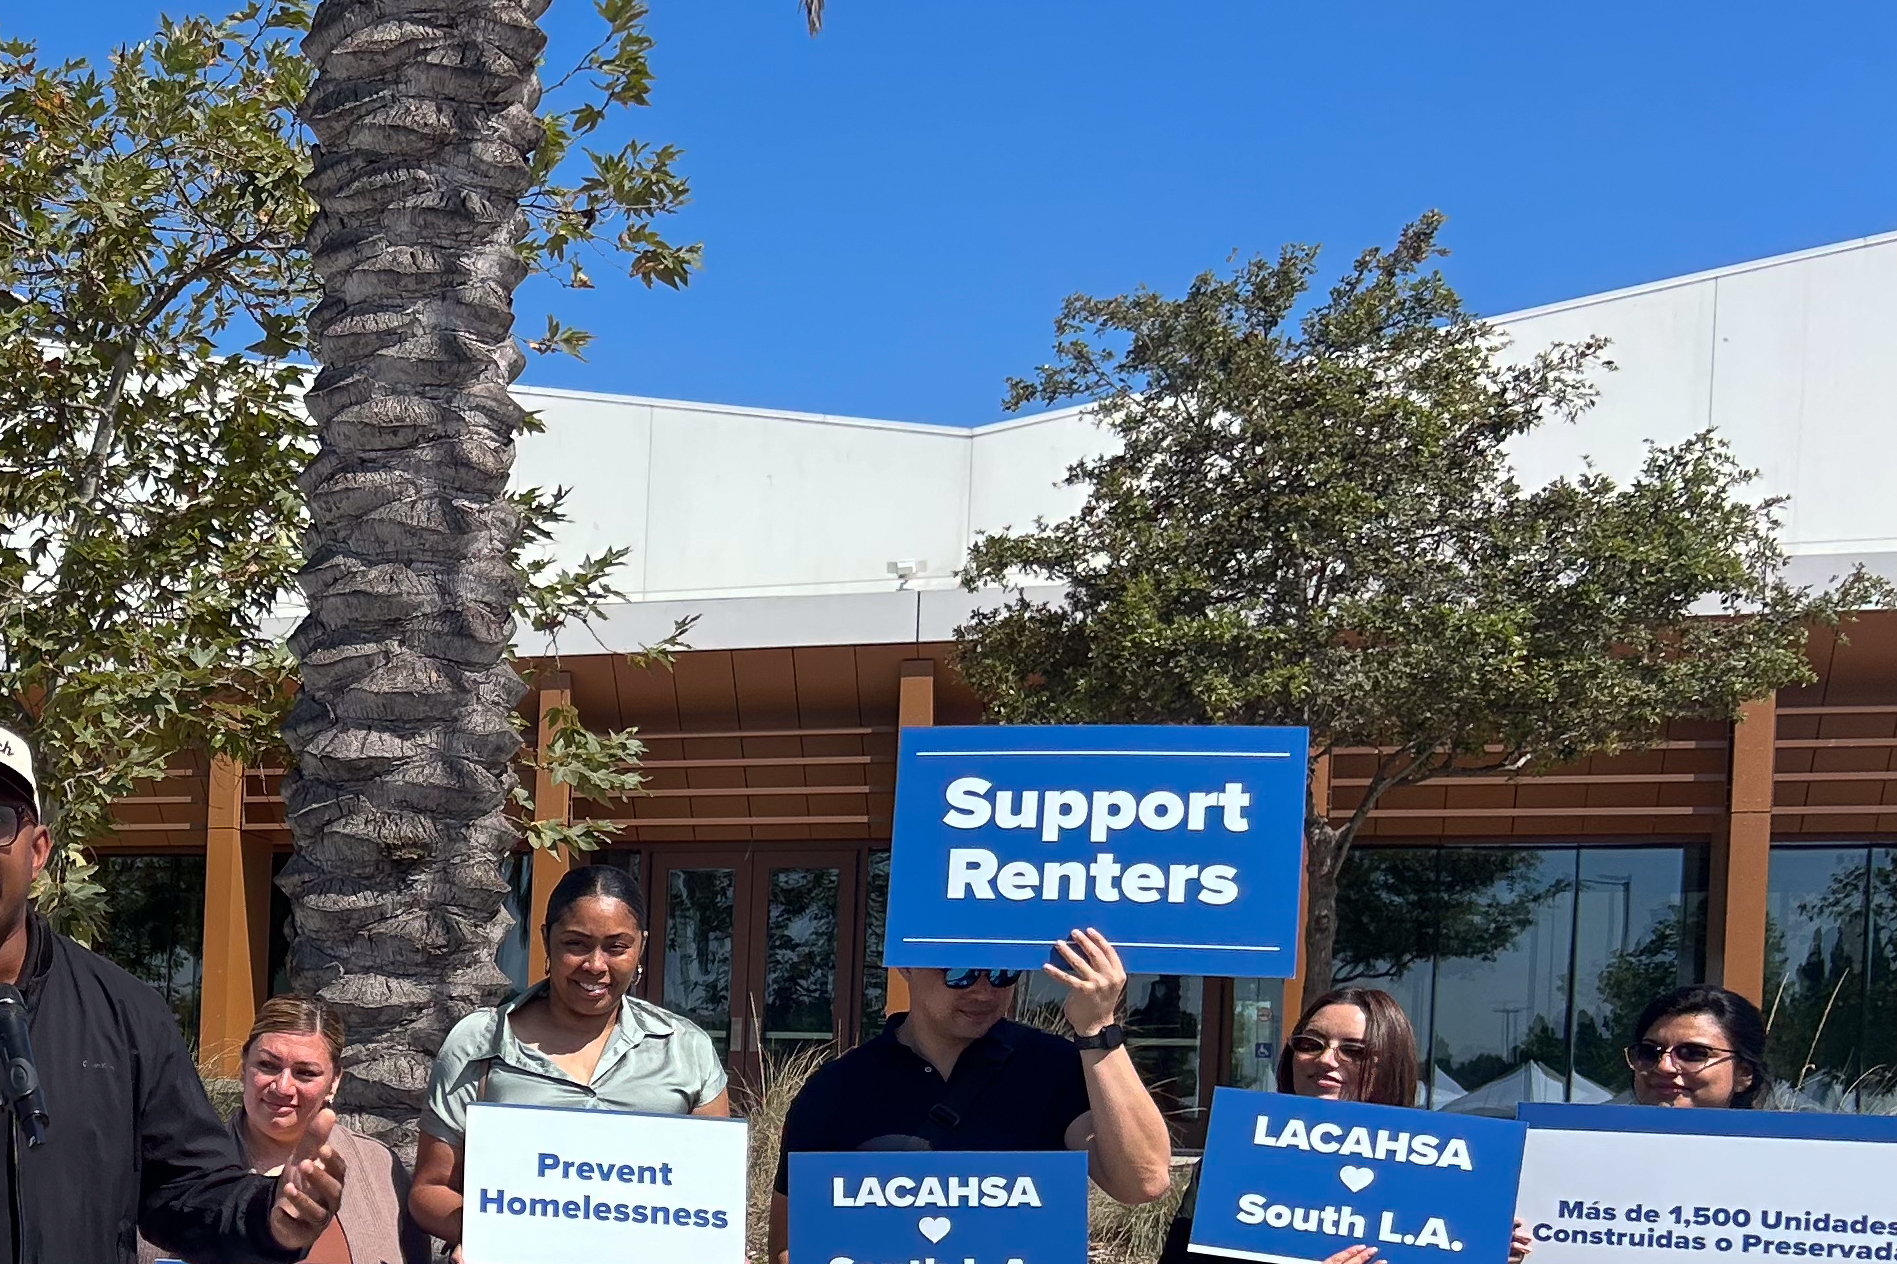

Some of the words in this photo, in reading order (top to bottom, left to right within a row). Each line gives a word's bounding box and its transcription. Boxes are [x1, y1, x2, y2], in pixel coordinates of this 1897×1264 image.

[942, 776, 1252, 843] Support
[946, 847, 1240, 906] Renters
[1253, 1114, 1474, 1172] LACAHSA
[537, 1152, 673, 1186] Prevent
[479, 1188, 729, 1229] Homelessness
[832, 1175, 1043, 1208] LACAHSA
[1235, 1193, 1366, 1239] South
[1378, 1210, 1464, 1253] L.A.
[1558, 1199, 1617, 1221] Más
[1625, 1204, 1661, 1224] de
[1668, 1206, 1751, 1228] 1,500
[1761, 1209, 1897, 1236] Unidades
[1532, 1223, 1706, 1251] Construidas
[1715, 1236, 1734, 1252] o
[1742, 1233, 1897, 1261] Preservad
